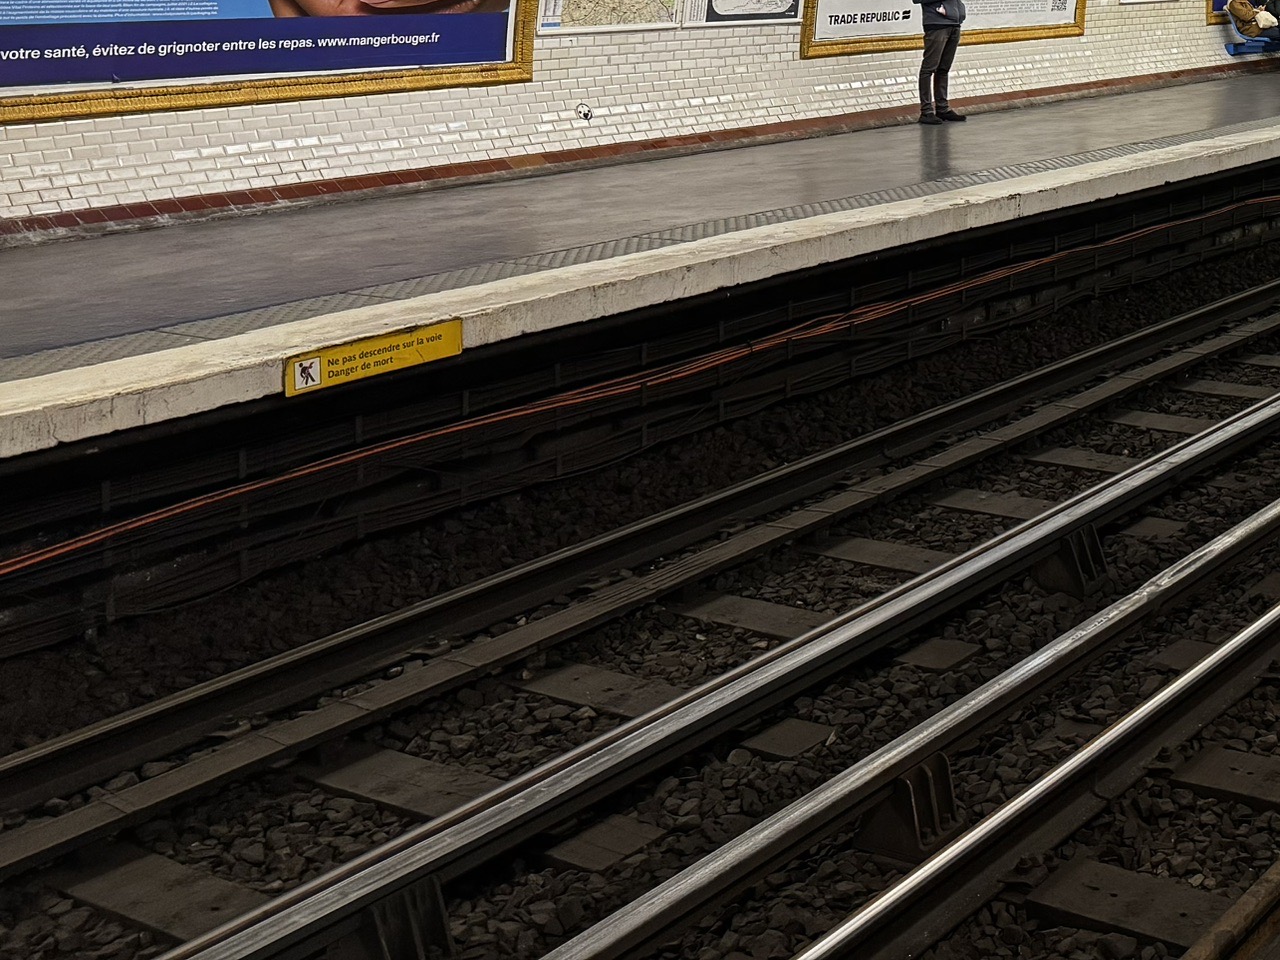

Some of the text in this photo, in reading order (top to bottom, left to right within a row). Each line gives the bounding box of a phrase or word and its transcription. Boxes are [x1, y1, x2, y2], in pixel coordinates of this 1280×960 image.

[828, 11, 900, 26] TRADE REPUBLIC
[0, 31, 440, 60] votre santé, évitez de grignoter entre les repas. www.mangerbouger.fr
[327, 332, 443, 367] Ne pas descendre sur la voie
[327, 356, 394, 377] Danger de mort
